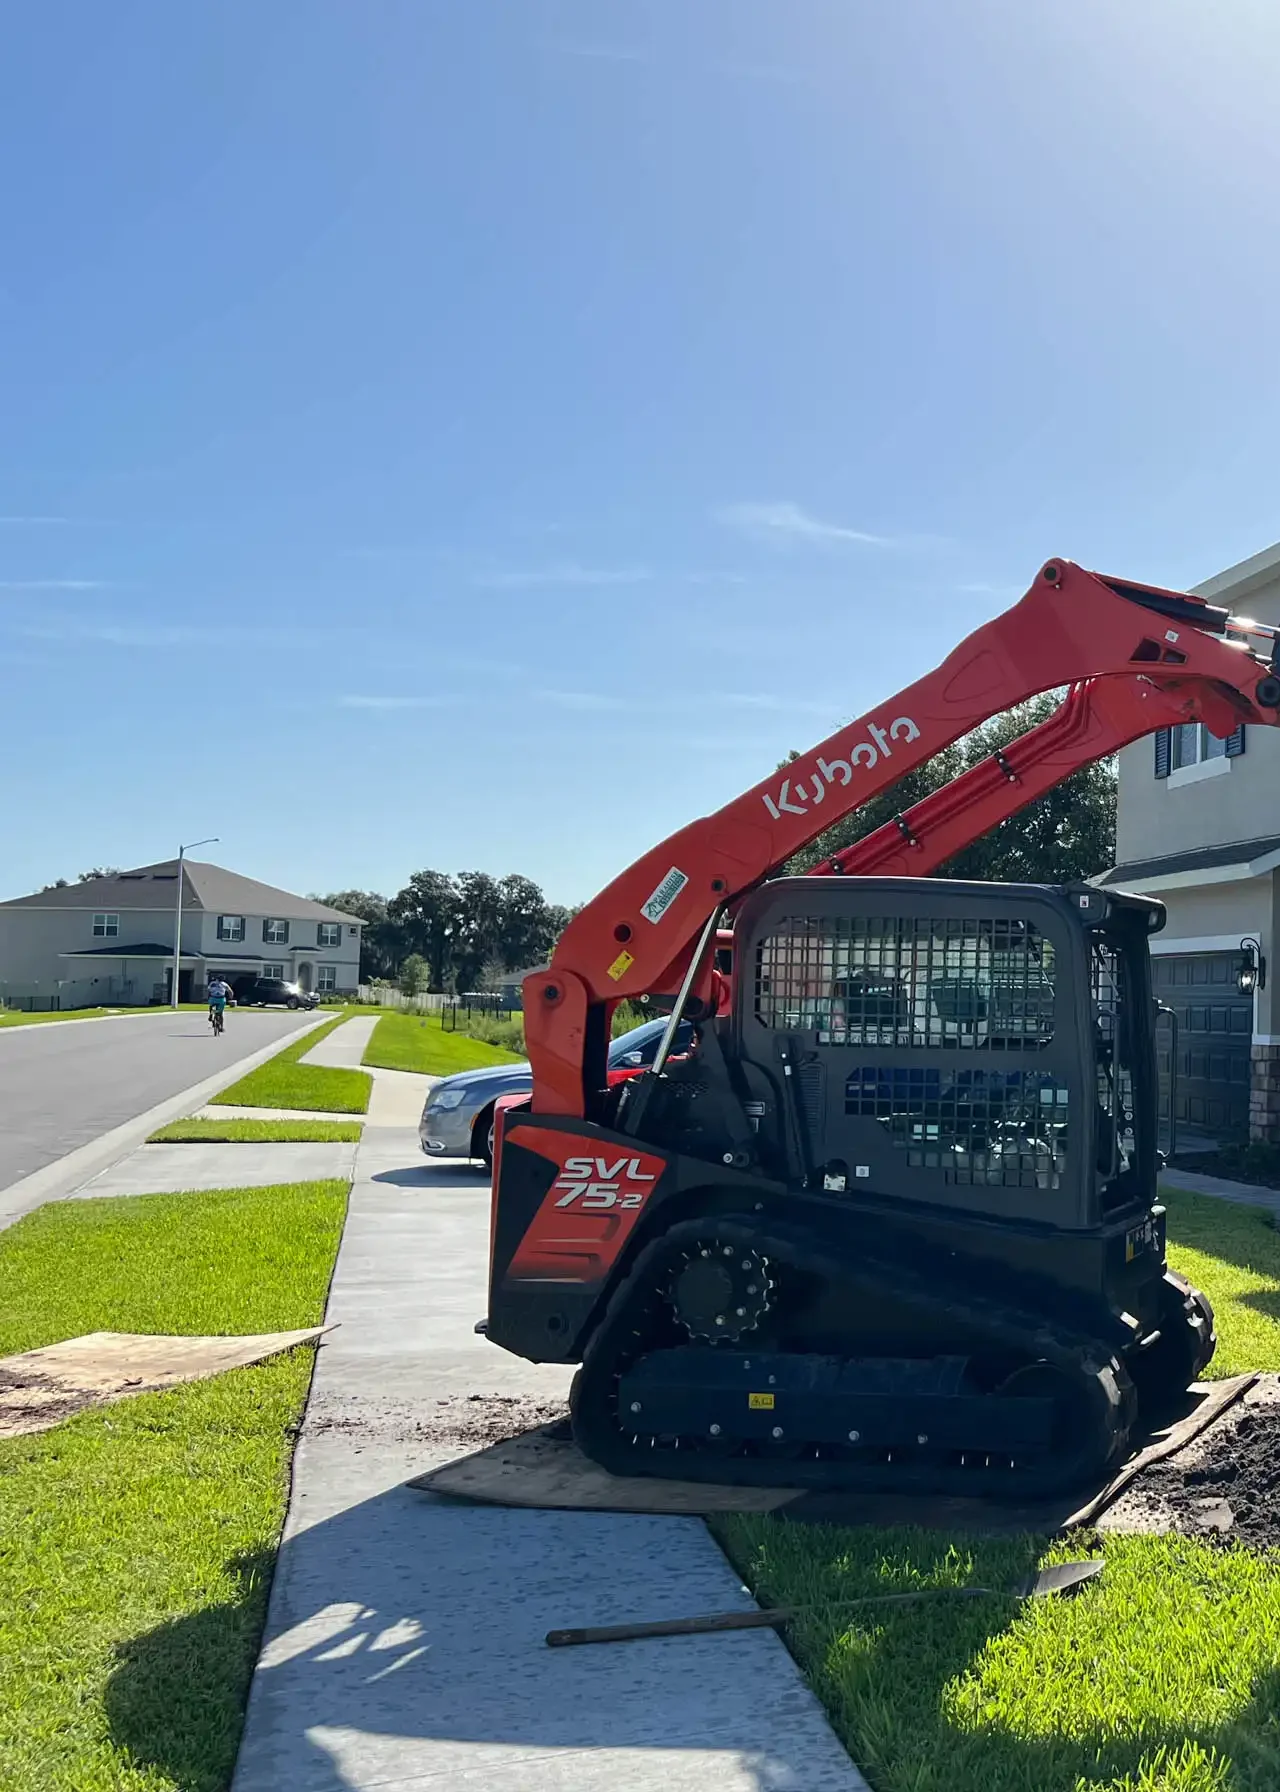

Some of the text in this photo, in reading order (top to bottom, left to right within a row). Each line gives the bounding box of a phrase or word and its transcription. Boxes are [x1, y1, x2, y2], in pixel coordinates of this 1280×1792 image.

[761, 716, 921, 820] Kubota
[560, 1156, 655, 1182] SVL
[554, 1182, 644, 1210] 75-2
